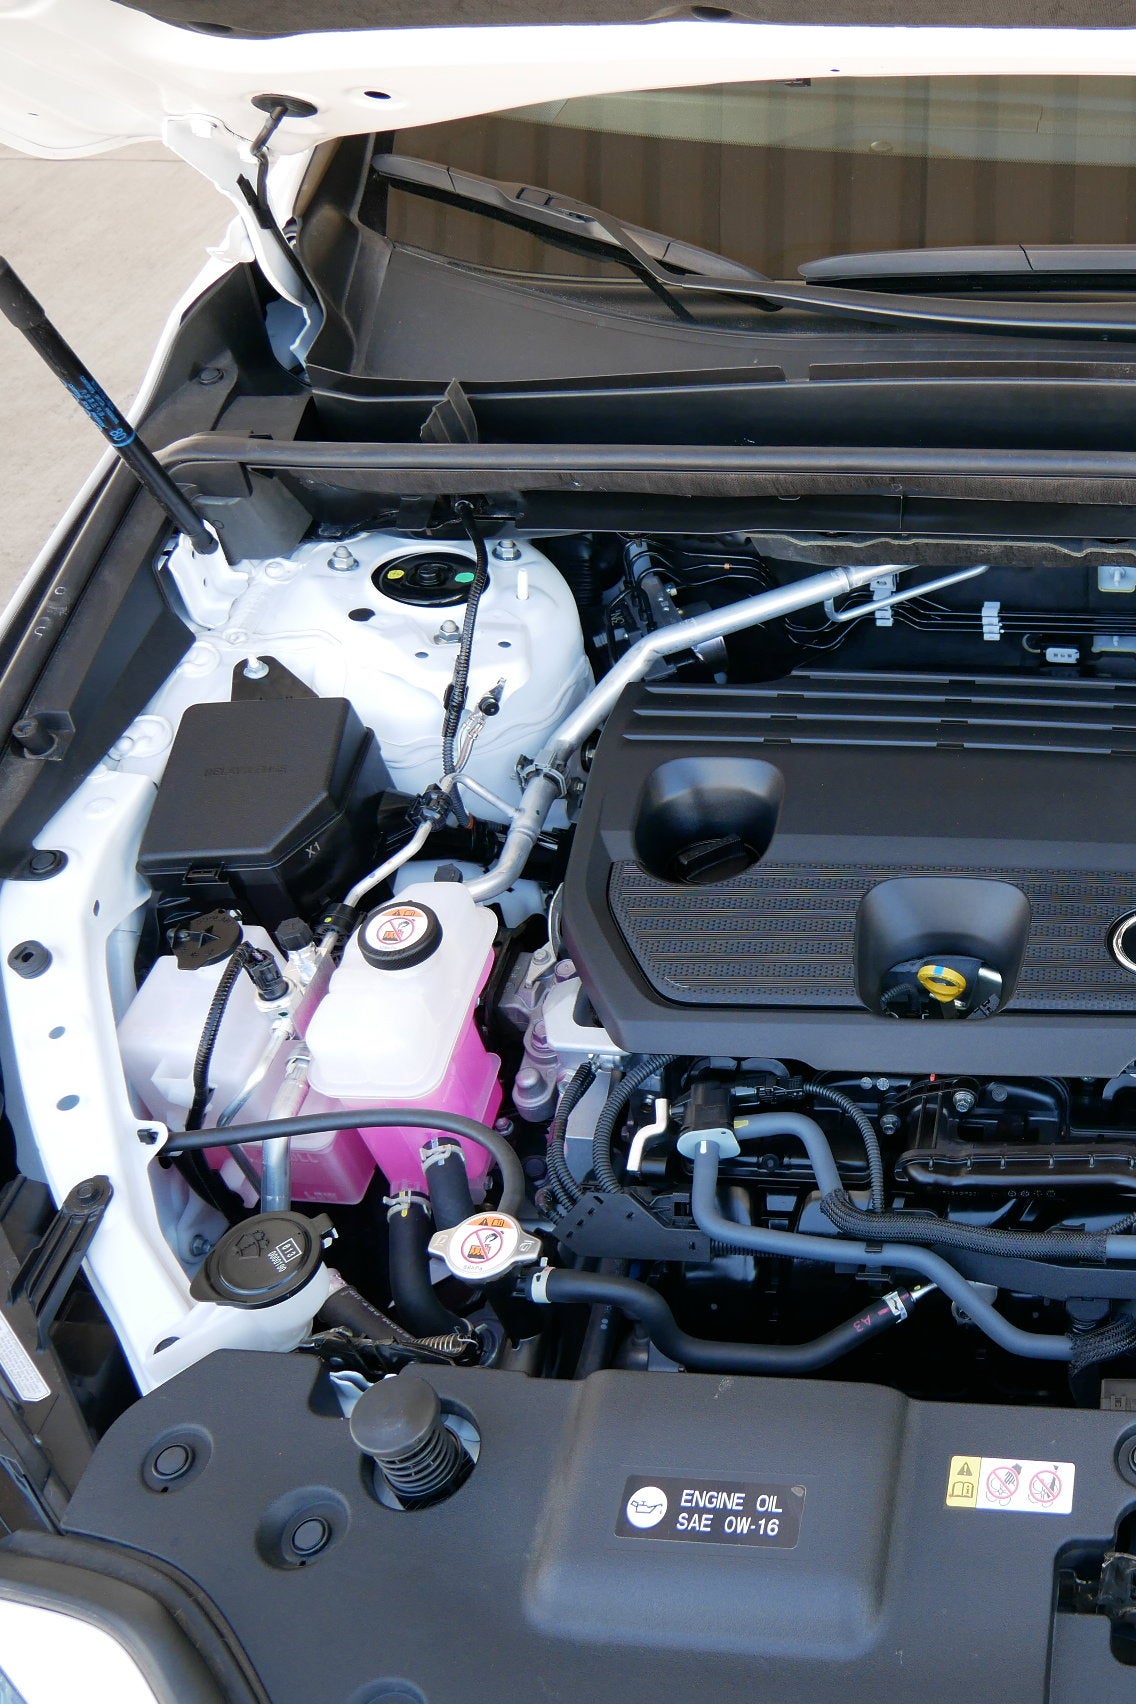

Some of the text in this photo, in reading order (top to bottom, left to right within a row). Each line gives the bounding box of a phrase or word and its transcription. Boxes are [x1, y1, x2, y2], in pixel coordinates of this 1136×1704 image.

[680, 1489, 783, 1513] ENGINE OIL
[676, 1512, 779, 1536] SAE 0W-16
